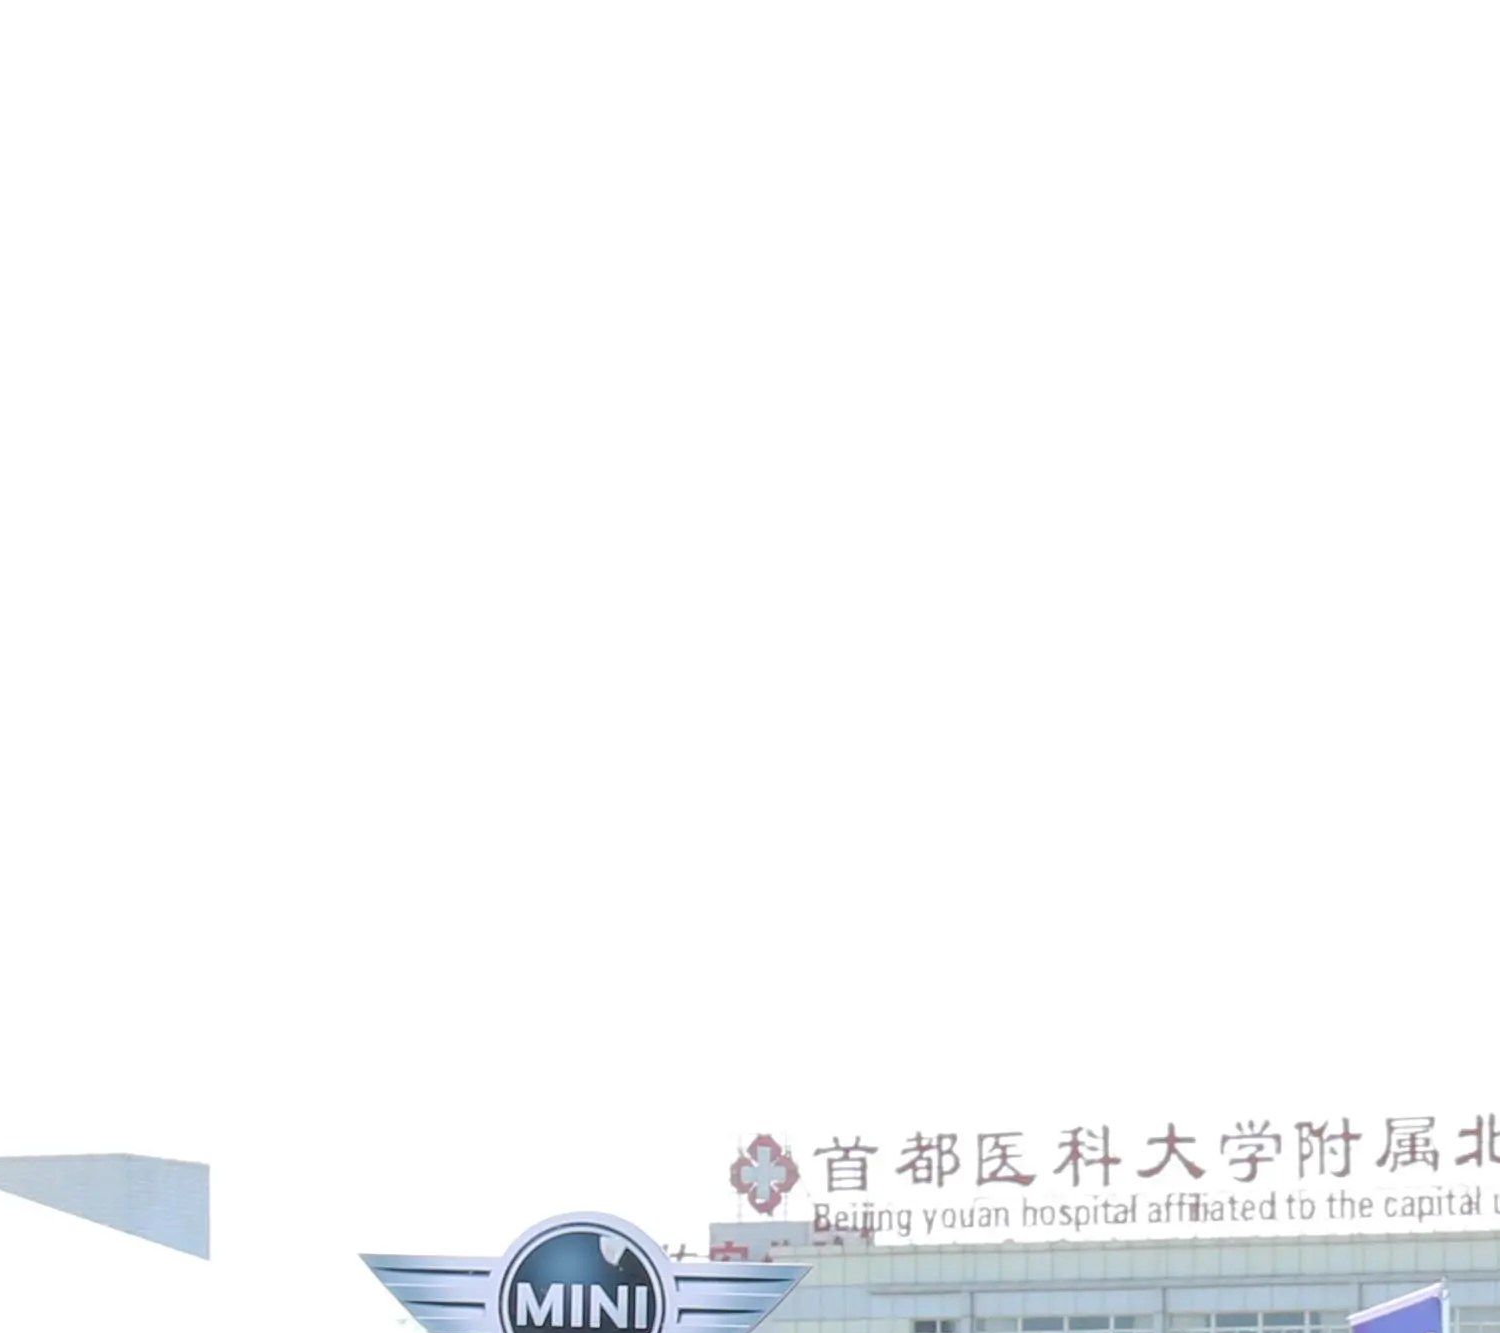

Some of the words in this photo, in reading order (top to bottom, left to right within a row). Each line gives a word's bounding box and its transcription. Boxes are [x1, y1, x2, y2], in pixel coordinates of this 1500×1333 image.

[813, 1203, 912, 1237] Beijing
[1022, 1195, 1137, 1232] hospital
[1285, 1192, 1316, 1220] to
[1327, 1189, 1373, 1220] the
[1382, 1184, 1482, 1221] capital
[516, 1283, 648, 1329] MINI
